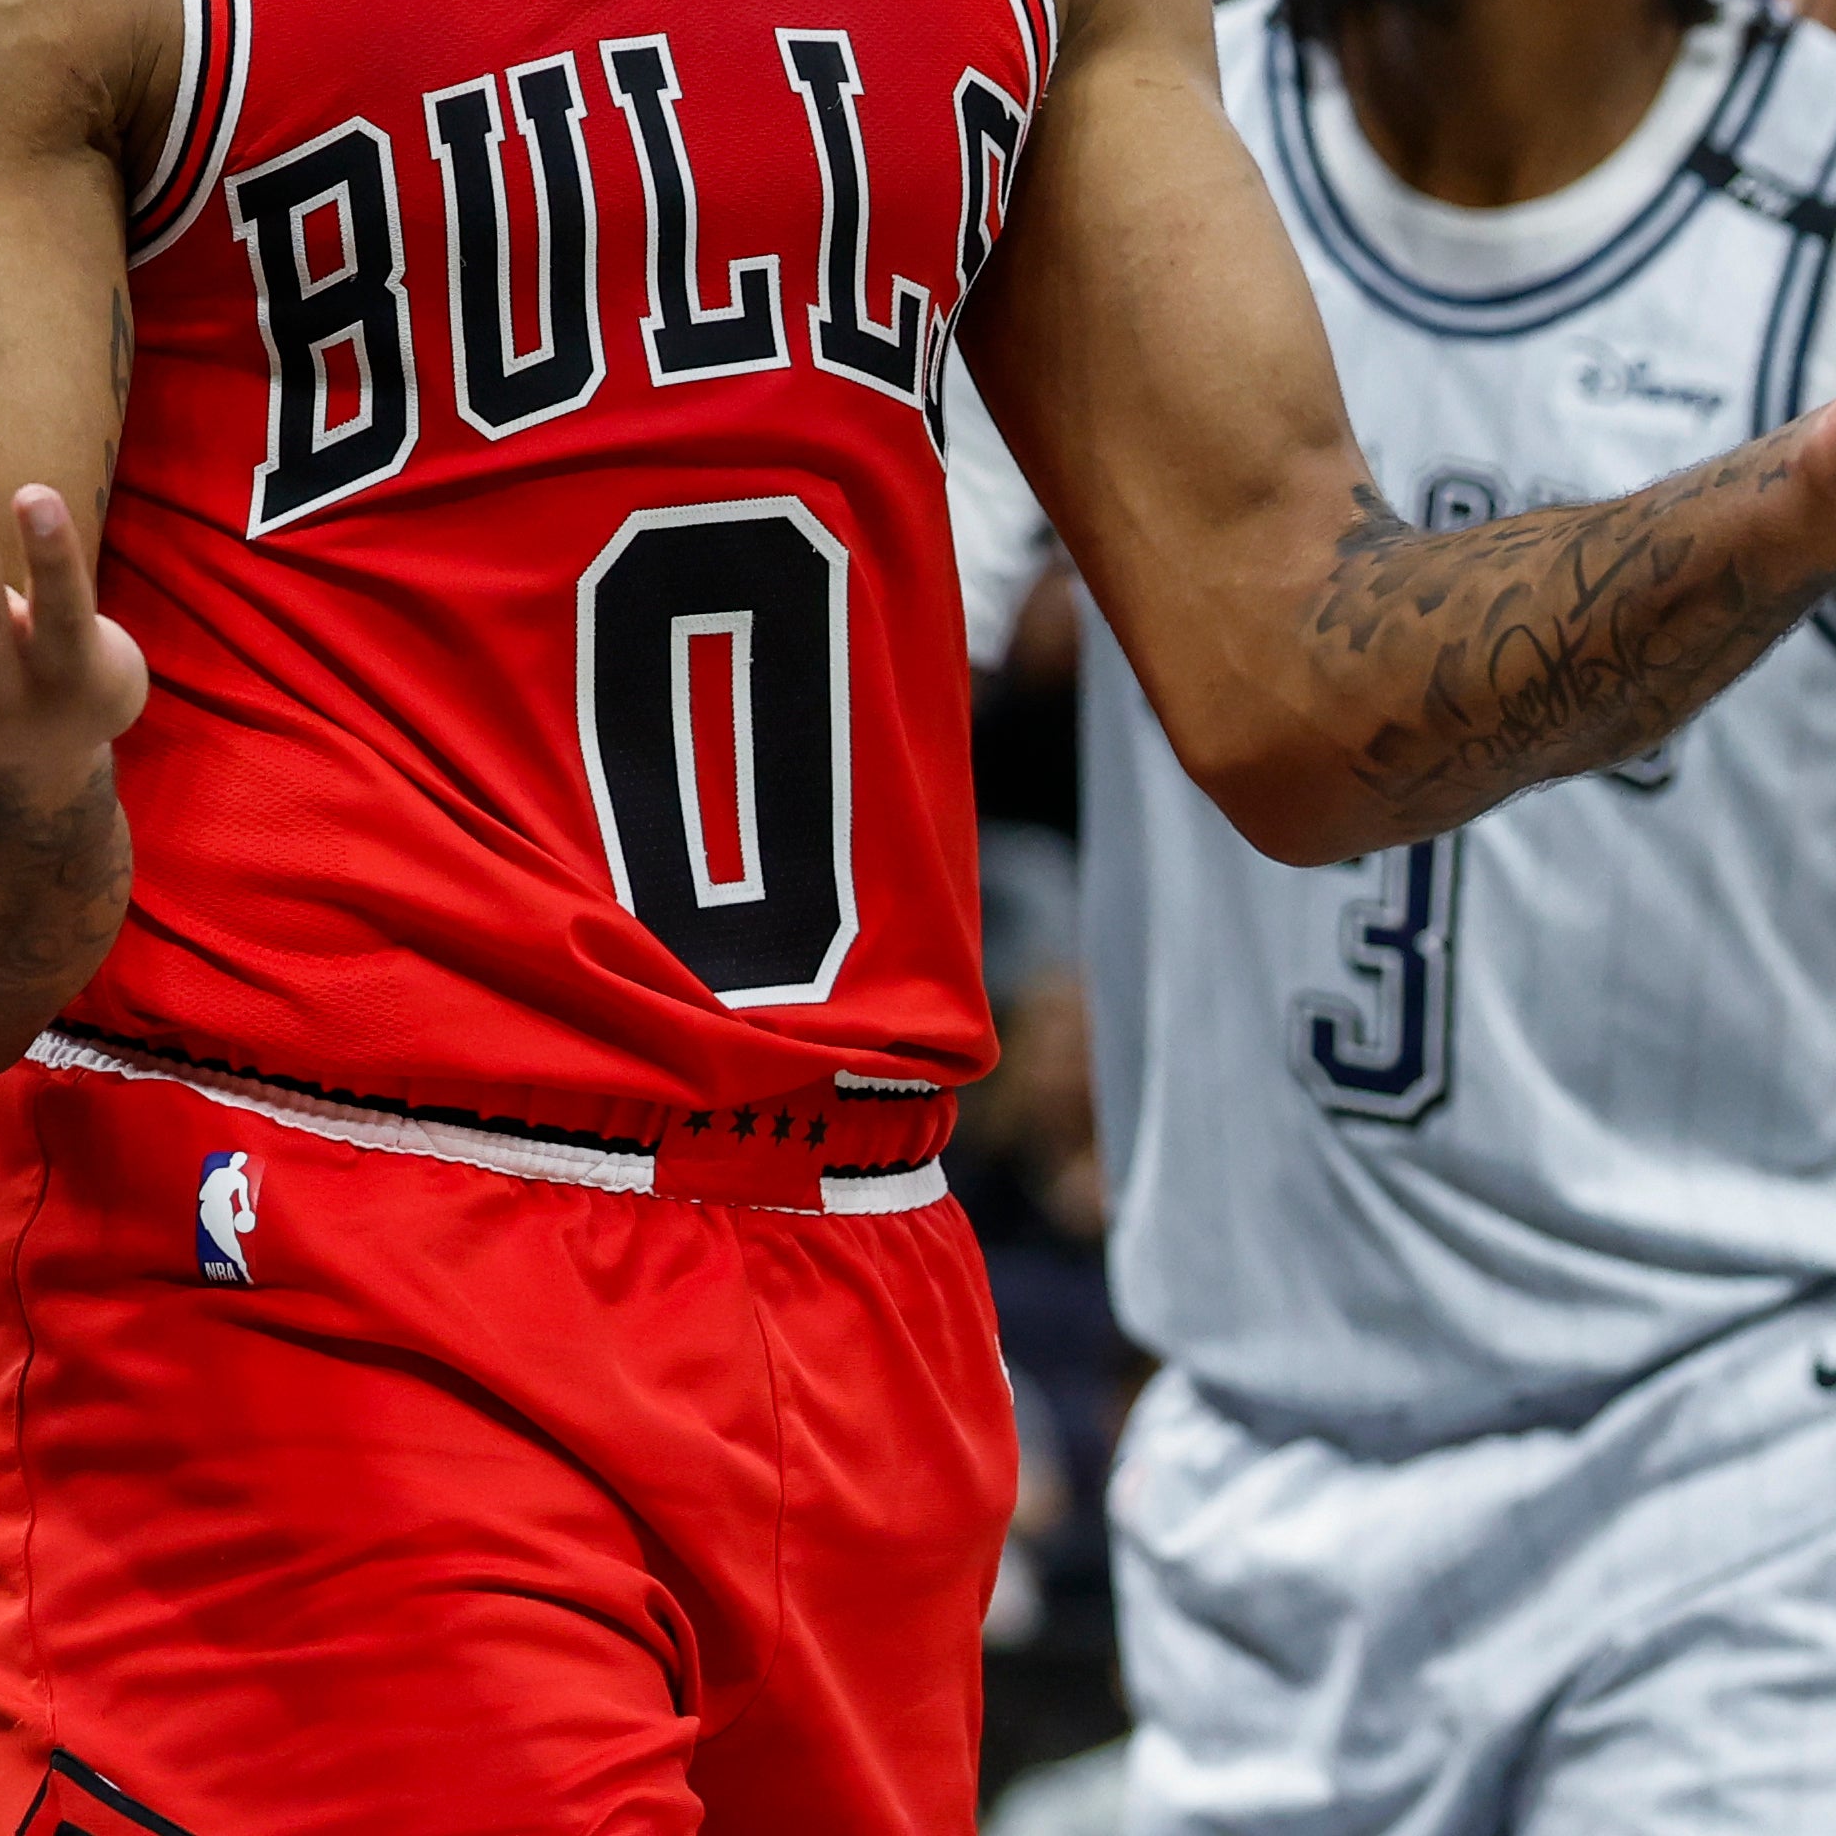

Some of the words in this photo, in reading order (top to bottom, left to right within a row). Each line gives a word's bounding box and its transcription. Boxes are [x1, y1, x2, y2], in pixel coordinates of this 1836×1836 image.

[576, 495, 859, 1011] 0
[1287, 824, 1468, 1126] 3
[204, 1262, 239, 1282] NBA
